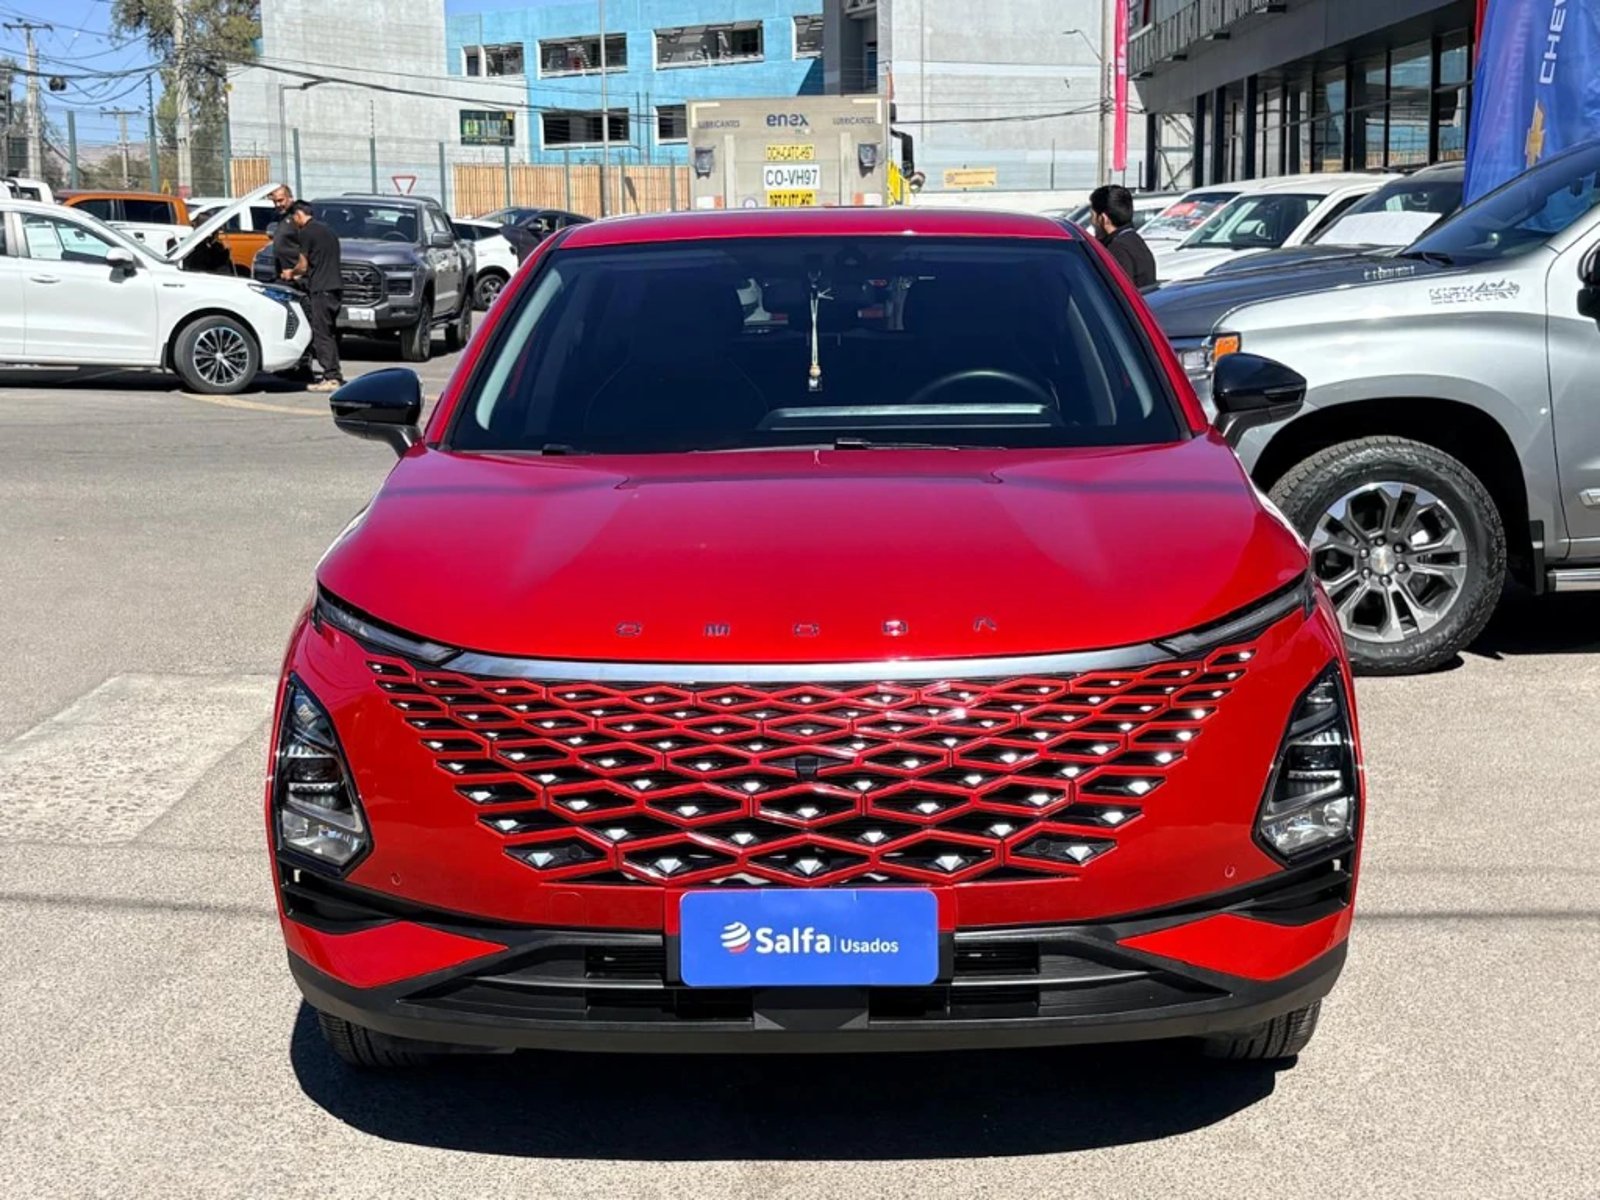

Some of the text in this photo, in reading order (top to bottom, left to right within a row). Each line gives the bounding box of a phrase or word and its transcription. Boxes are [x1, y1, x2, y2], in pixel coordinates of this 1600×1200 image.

[1539, 0, 1568, 84] CHE
[765, 169, 818, 186] CO-VH97
[755, 926, 900, 954] Salfa Usados
